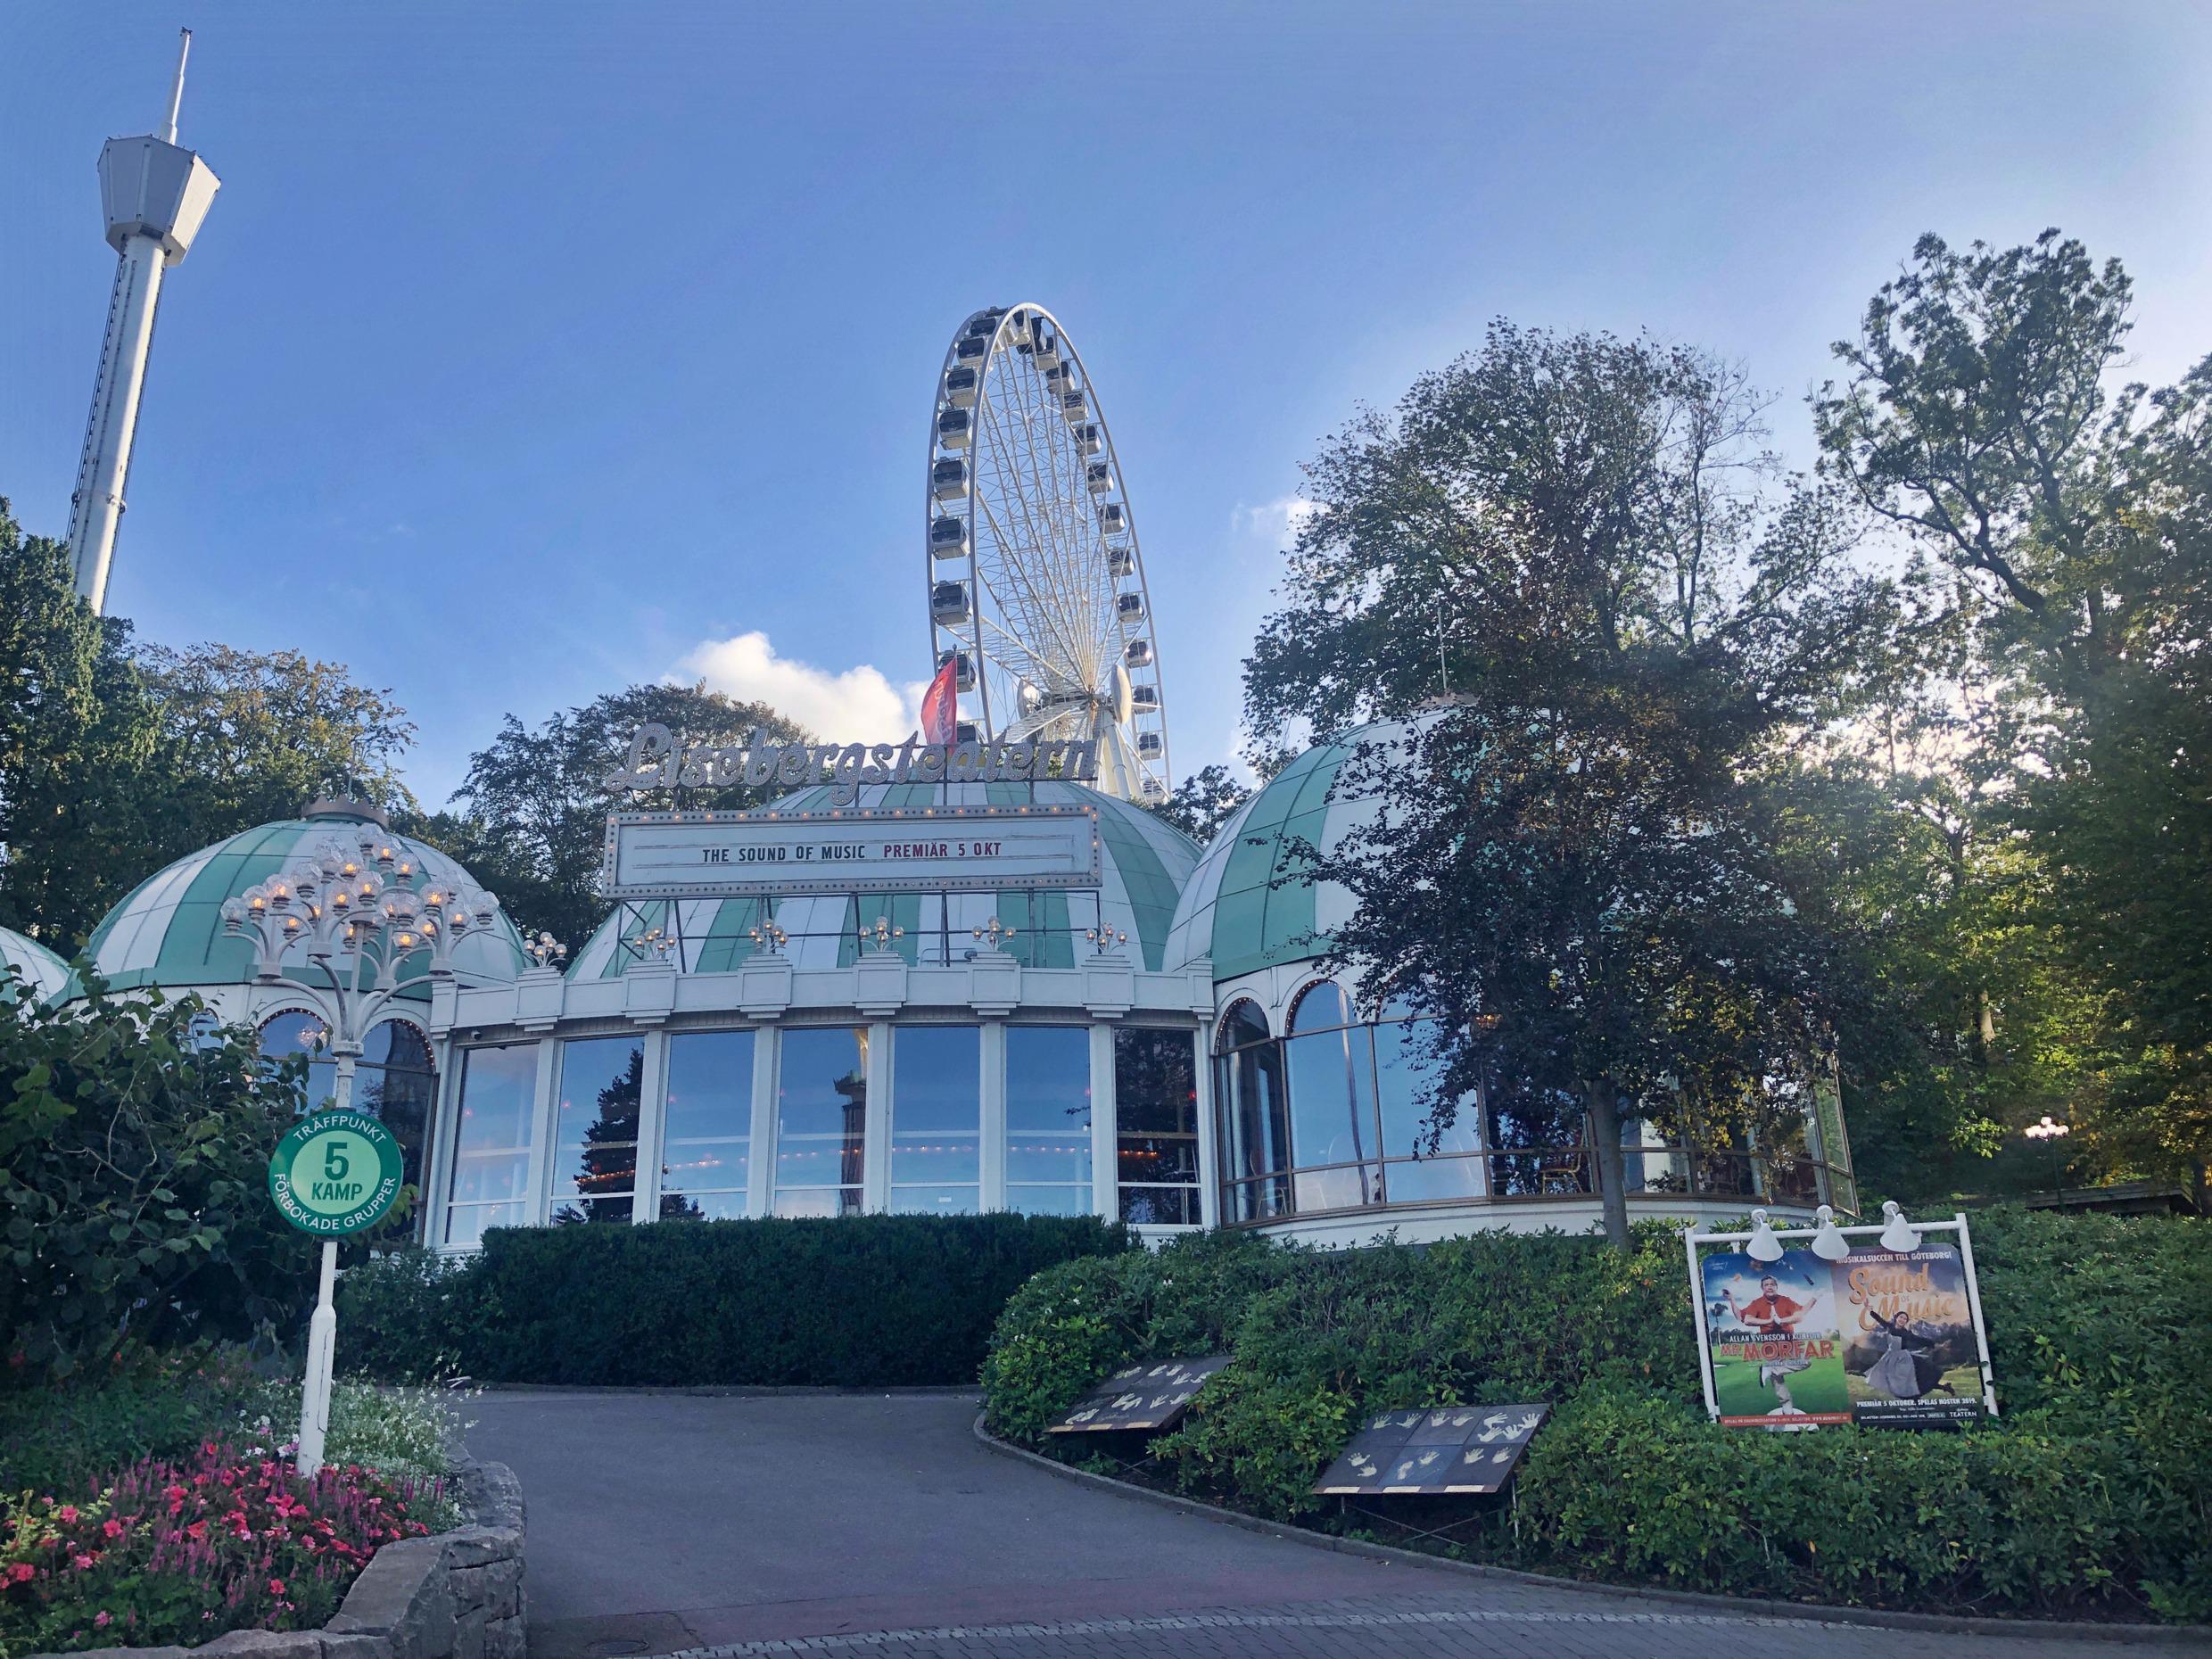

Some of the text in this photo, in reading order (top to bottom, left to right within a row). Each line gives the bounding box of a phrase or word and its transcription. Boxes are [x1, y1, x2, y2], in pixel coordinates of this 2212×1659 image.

[606, 722, 1098, 806] Lisebergsteatern
[702, 842, 1002, 863] THE SOUND OF MUSIC PREMIÄR 5 OKT
[293, 1115, 387, 1143] TRÄFFPUNKT
[324, 1142, 350, 1181] 5
[274, 1173, 396, 1231] FÖRBOKADE GRUPPER
[312, 1182, 363, 1201] KAMP
[1895, 1253, 1910, 1262] TILL
[1911, 1250, 1952, 1260] GÖTEBORG!
[1848, 1262, 1929, 1305] Sound
[1729, 1334, 1750, 1342] ALLAN
[1751, 1333, 1786, 1341] SVENSSON
[1742, 1340, 1836, 1362] MORFAR
